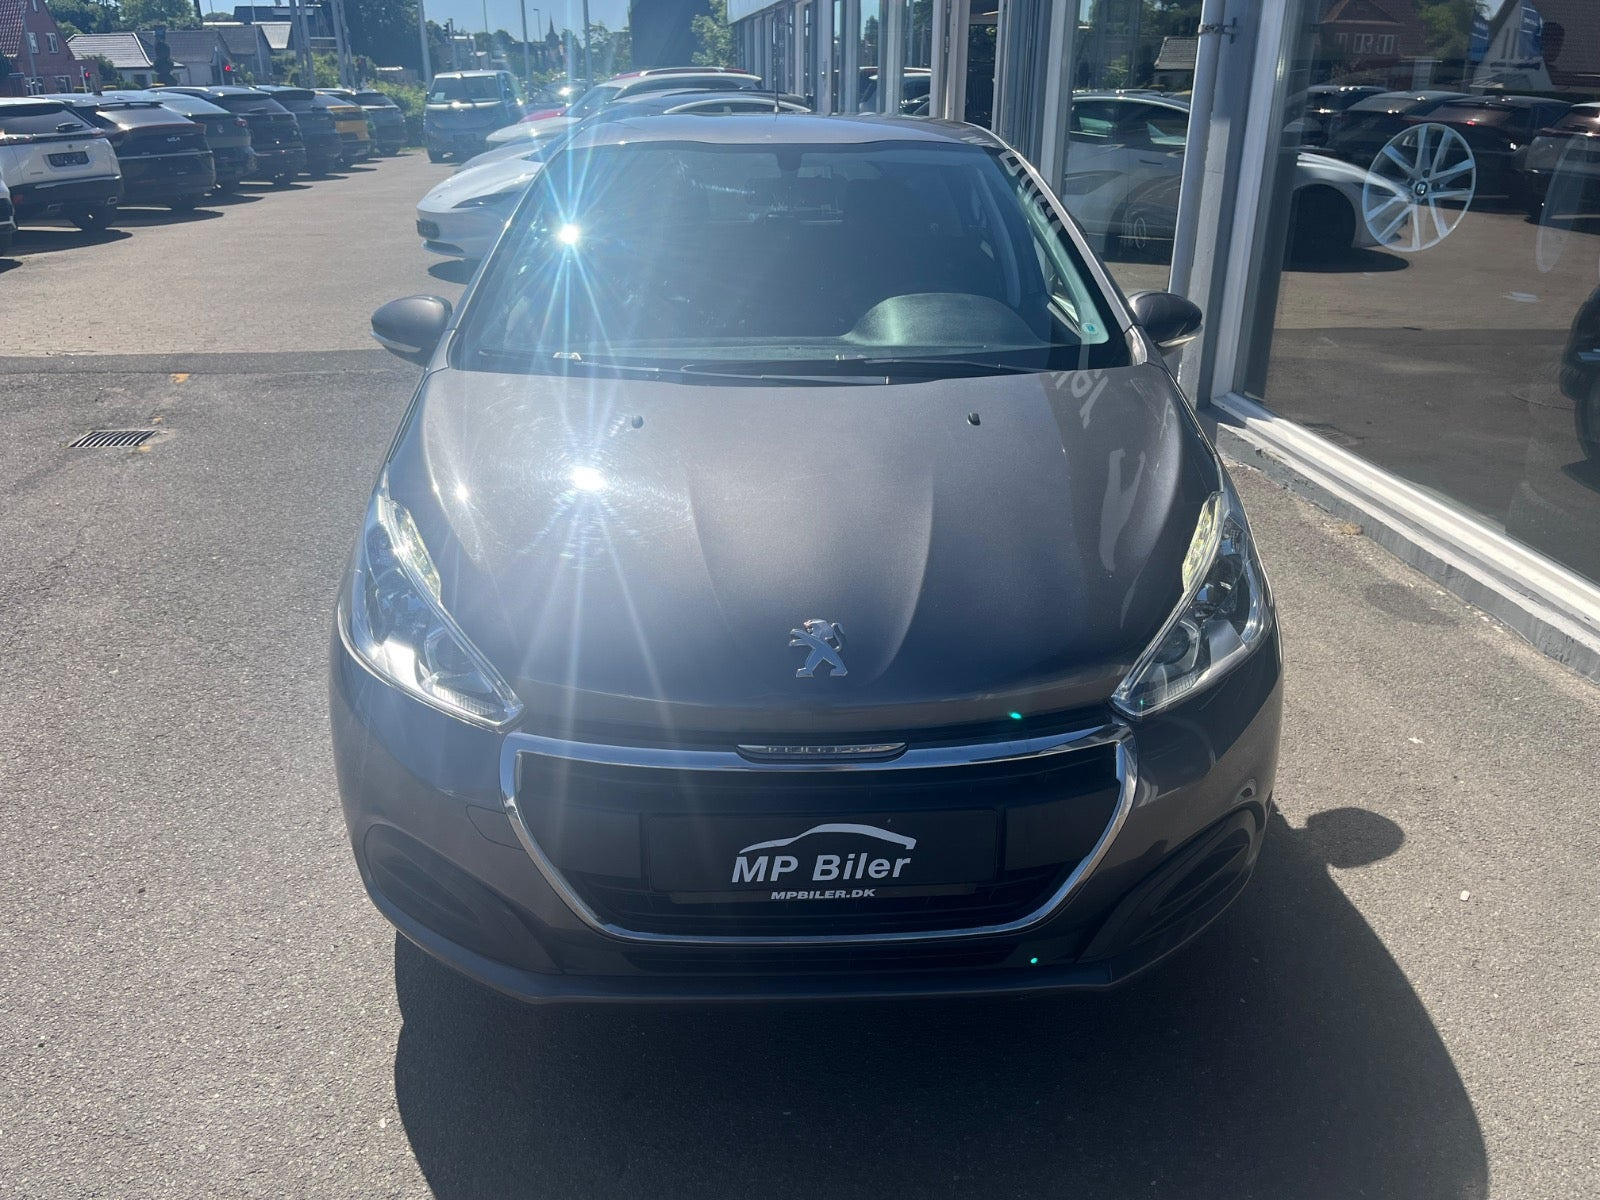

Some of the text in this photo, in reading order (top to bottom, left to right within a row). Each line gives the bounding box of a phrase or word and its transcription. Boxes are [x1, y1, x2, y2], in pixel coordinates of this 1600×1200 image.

[731, 852, 912, 883] MP Biler
[770, 888, 876, 900] MPBILER.DK
